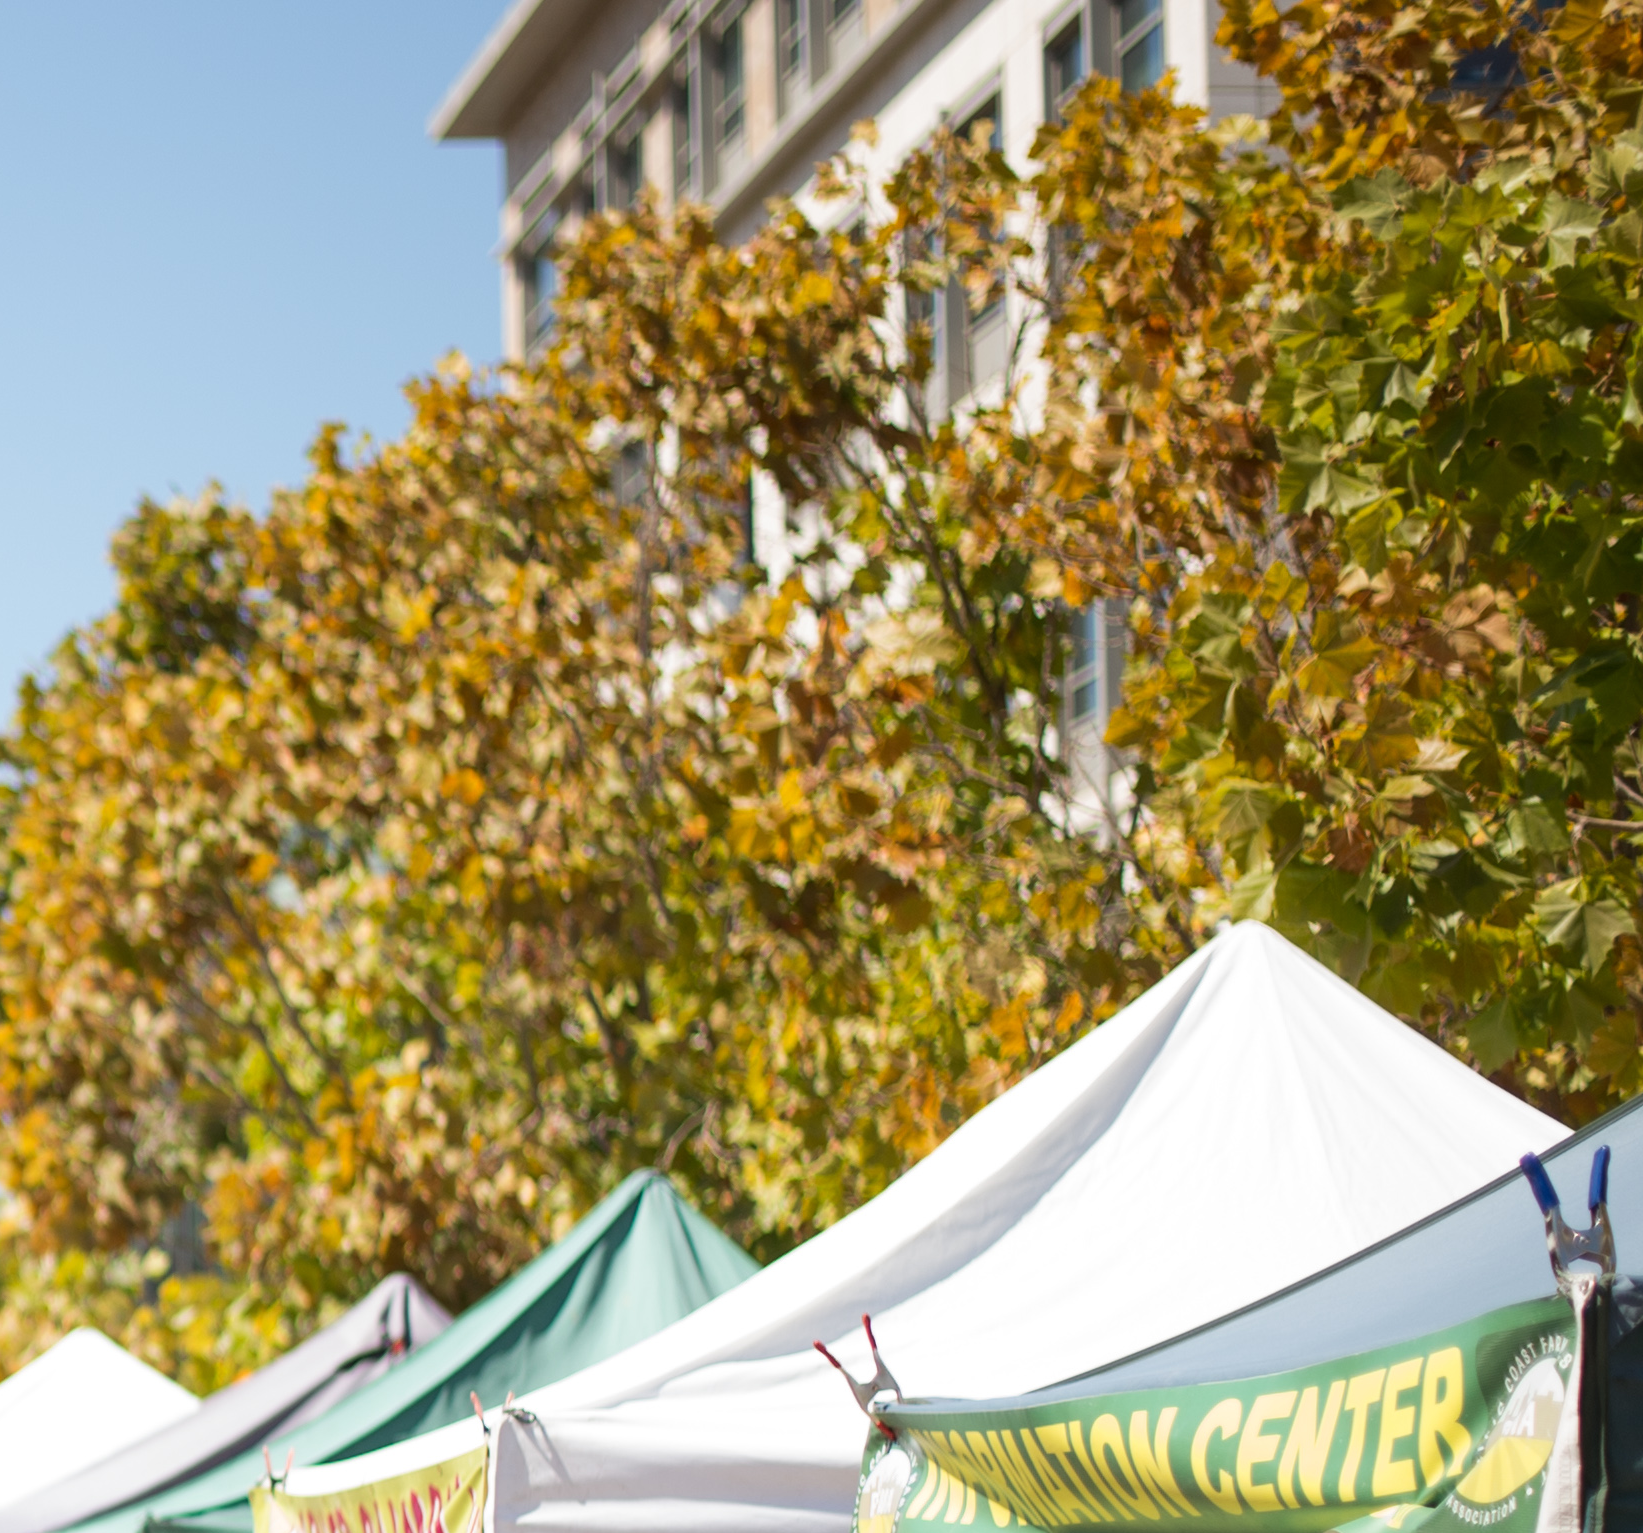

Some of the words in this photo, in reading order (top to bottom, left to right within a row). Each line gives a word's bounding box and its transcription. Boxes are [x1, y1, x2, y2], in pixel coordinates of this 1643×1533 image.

[906, 1406, 1202, 1528] INFORMATION
[1190, 1346, 1472, 1515] CENTER
[1446, 1495, 1517, 1526] ASSOCIATION
